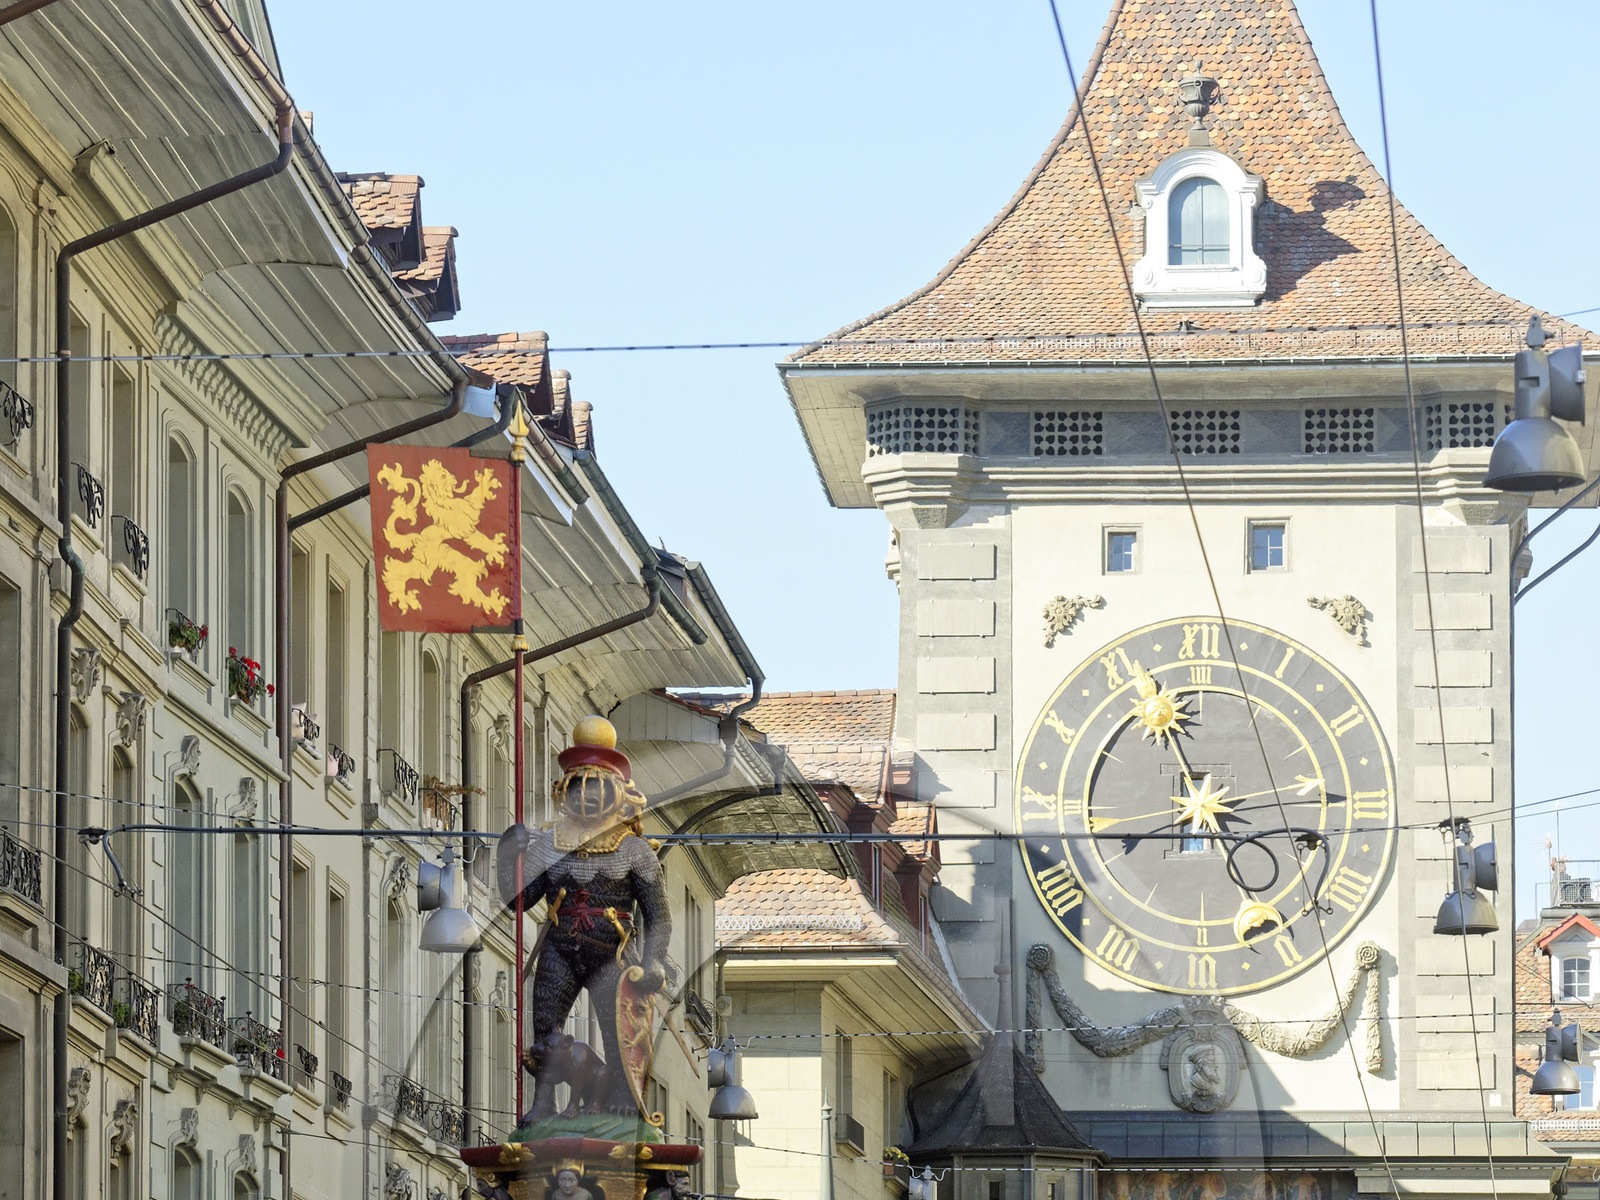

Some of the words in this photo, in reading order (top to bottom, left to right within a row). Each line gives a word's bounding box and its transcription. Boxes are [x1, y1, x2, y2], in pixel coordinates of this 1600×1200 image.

[1178, 623, 1221, 659] XII
[1099, 646, 1138, 690] XI
[1274, 646, 1296, 679] I
[1043, 709, 1076, 744] X
[1329, 704, 1365, 737] II
[1021, 785, 1058, 822] IX
[1353, 788, 1389, 820] III
